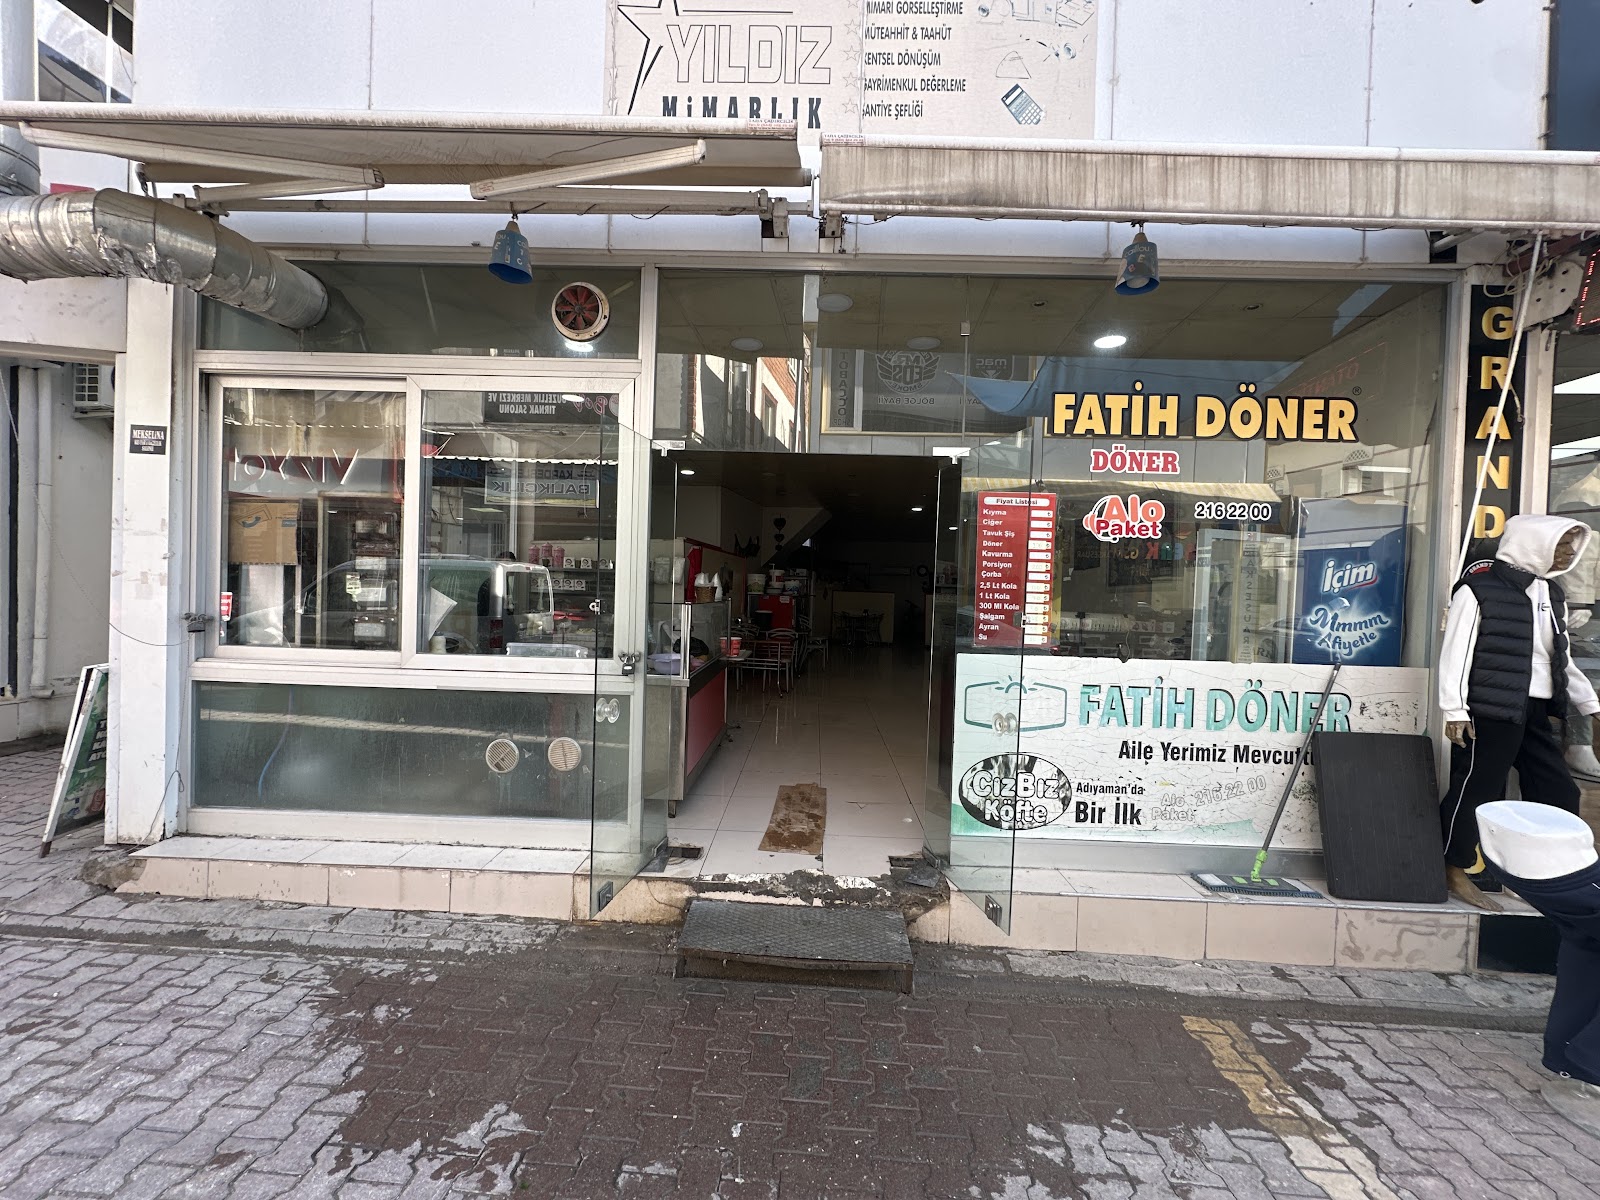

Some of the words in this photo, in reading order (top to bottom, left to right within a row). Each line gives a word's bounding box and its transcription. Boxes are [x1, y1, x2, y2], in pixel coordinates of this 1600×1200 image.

[912, 26, 918, 40] &
[921, 23, 952, 40] TAAHÜT
[666, 24, 832, 84] YILDIZ
[898, 49, 941, 69] DÖNÜŞÜM
[920, 74, 966, 92] DEĞERLEME
[895, 100, 923, 119] ŞEFLİĞİ
[1052, 380, 1180, 437] FATİH
[1194, 383, 1358, 442] DÖNER
[1474, 306, 1514, 538] GRAND
[1091, 445, 1179, 473] DÖNER
[983, 508, 1007, 516] Kıyma
[1103, 495, 1165, 523] Alo
[1195, 502, 1224, 519] 216
[1228, 503, 1247, 519] 22
[1251, 504, 1270, 520] 00
[1096, 518, 1161, 539] Paket
[982, 550, 1013, 558] Kavurma
[982, 560, 1012, 568] Porsiyon
[981, 570, 1002, 578] Çorba
[1323, 560, 1375, 594] İçim
[979, 582, 990, 590] 2,5
[979, 623, 999, 631] Ayran
[1317, 632, 1377, 657] Afiyetle
[1079, 676, 1195, 730] FATİH
[1206, 679, 1351, 733] DÖNER
[1119, 740, 1153, 760] Aile
[1160, 742, 1226, 763] Yerimiz
[1224, 781, 1245, 798] 22
[1247, 775, 1267, 792] 00
[984, 799, 1048, 823] Köfte
[1075, 801, 1106, 824] Bir
[1114, 797, 1142, 826] İlk
[1151, 807, 1195, 823] Paket
